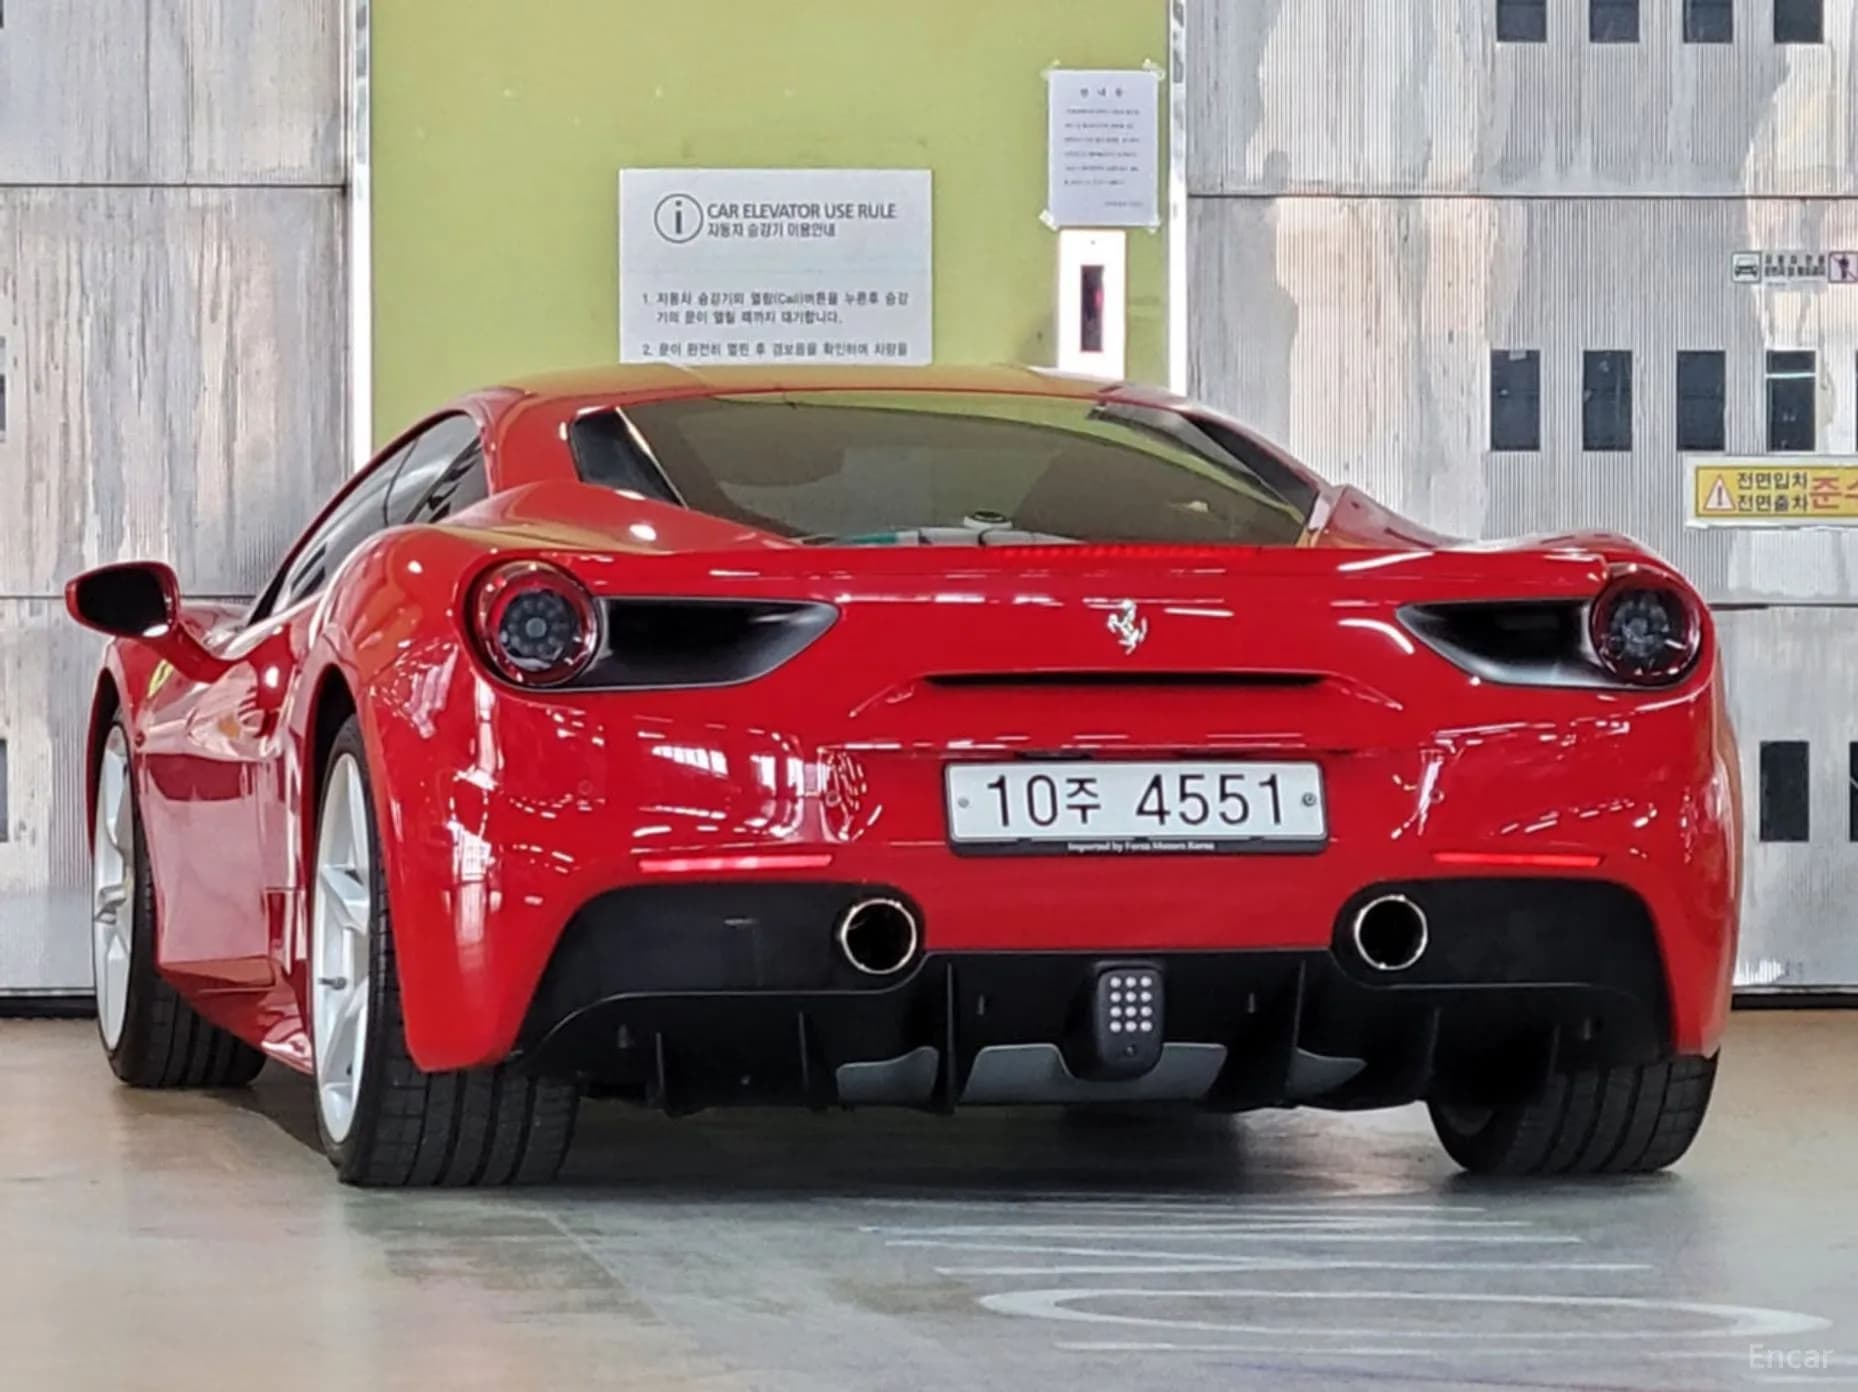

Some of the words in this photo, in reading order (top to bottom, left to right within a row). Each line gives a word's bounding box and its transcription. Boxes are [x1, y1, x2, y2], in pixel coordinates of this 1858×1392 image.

[707, 203, 740, 219] CAR
[743, 203, 821, 219] ELEVATOR
[825, 203, 855, 219] USE
[858, 203, 897, 219] RULE
[707, 223, 744, 238] 자동차
[749, 223, 784, 238] 승강기
[787, 223, 836, 238] 이용안내
[656, 291, 692, 306] 자동차
[1738, 472, 1808, 490] 전면입차
[1738, 494, 1808, 512] 전면출차
[986, 774, 1102, 827] 10주
[1135, 773, 1283, 826] 4551
